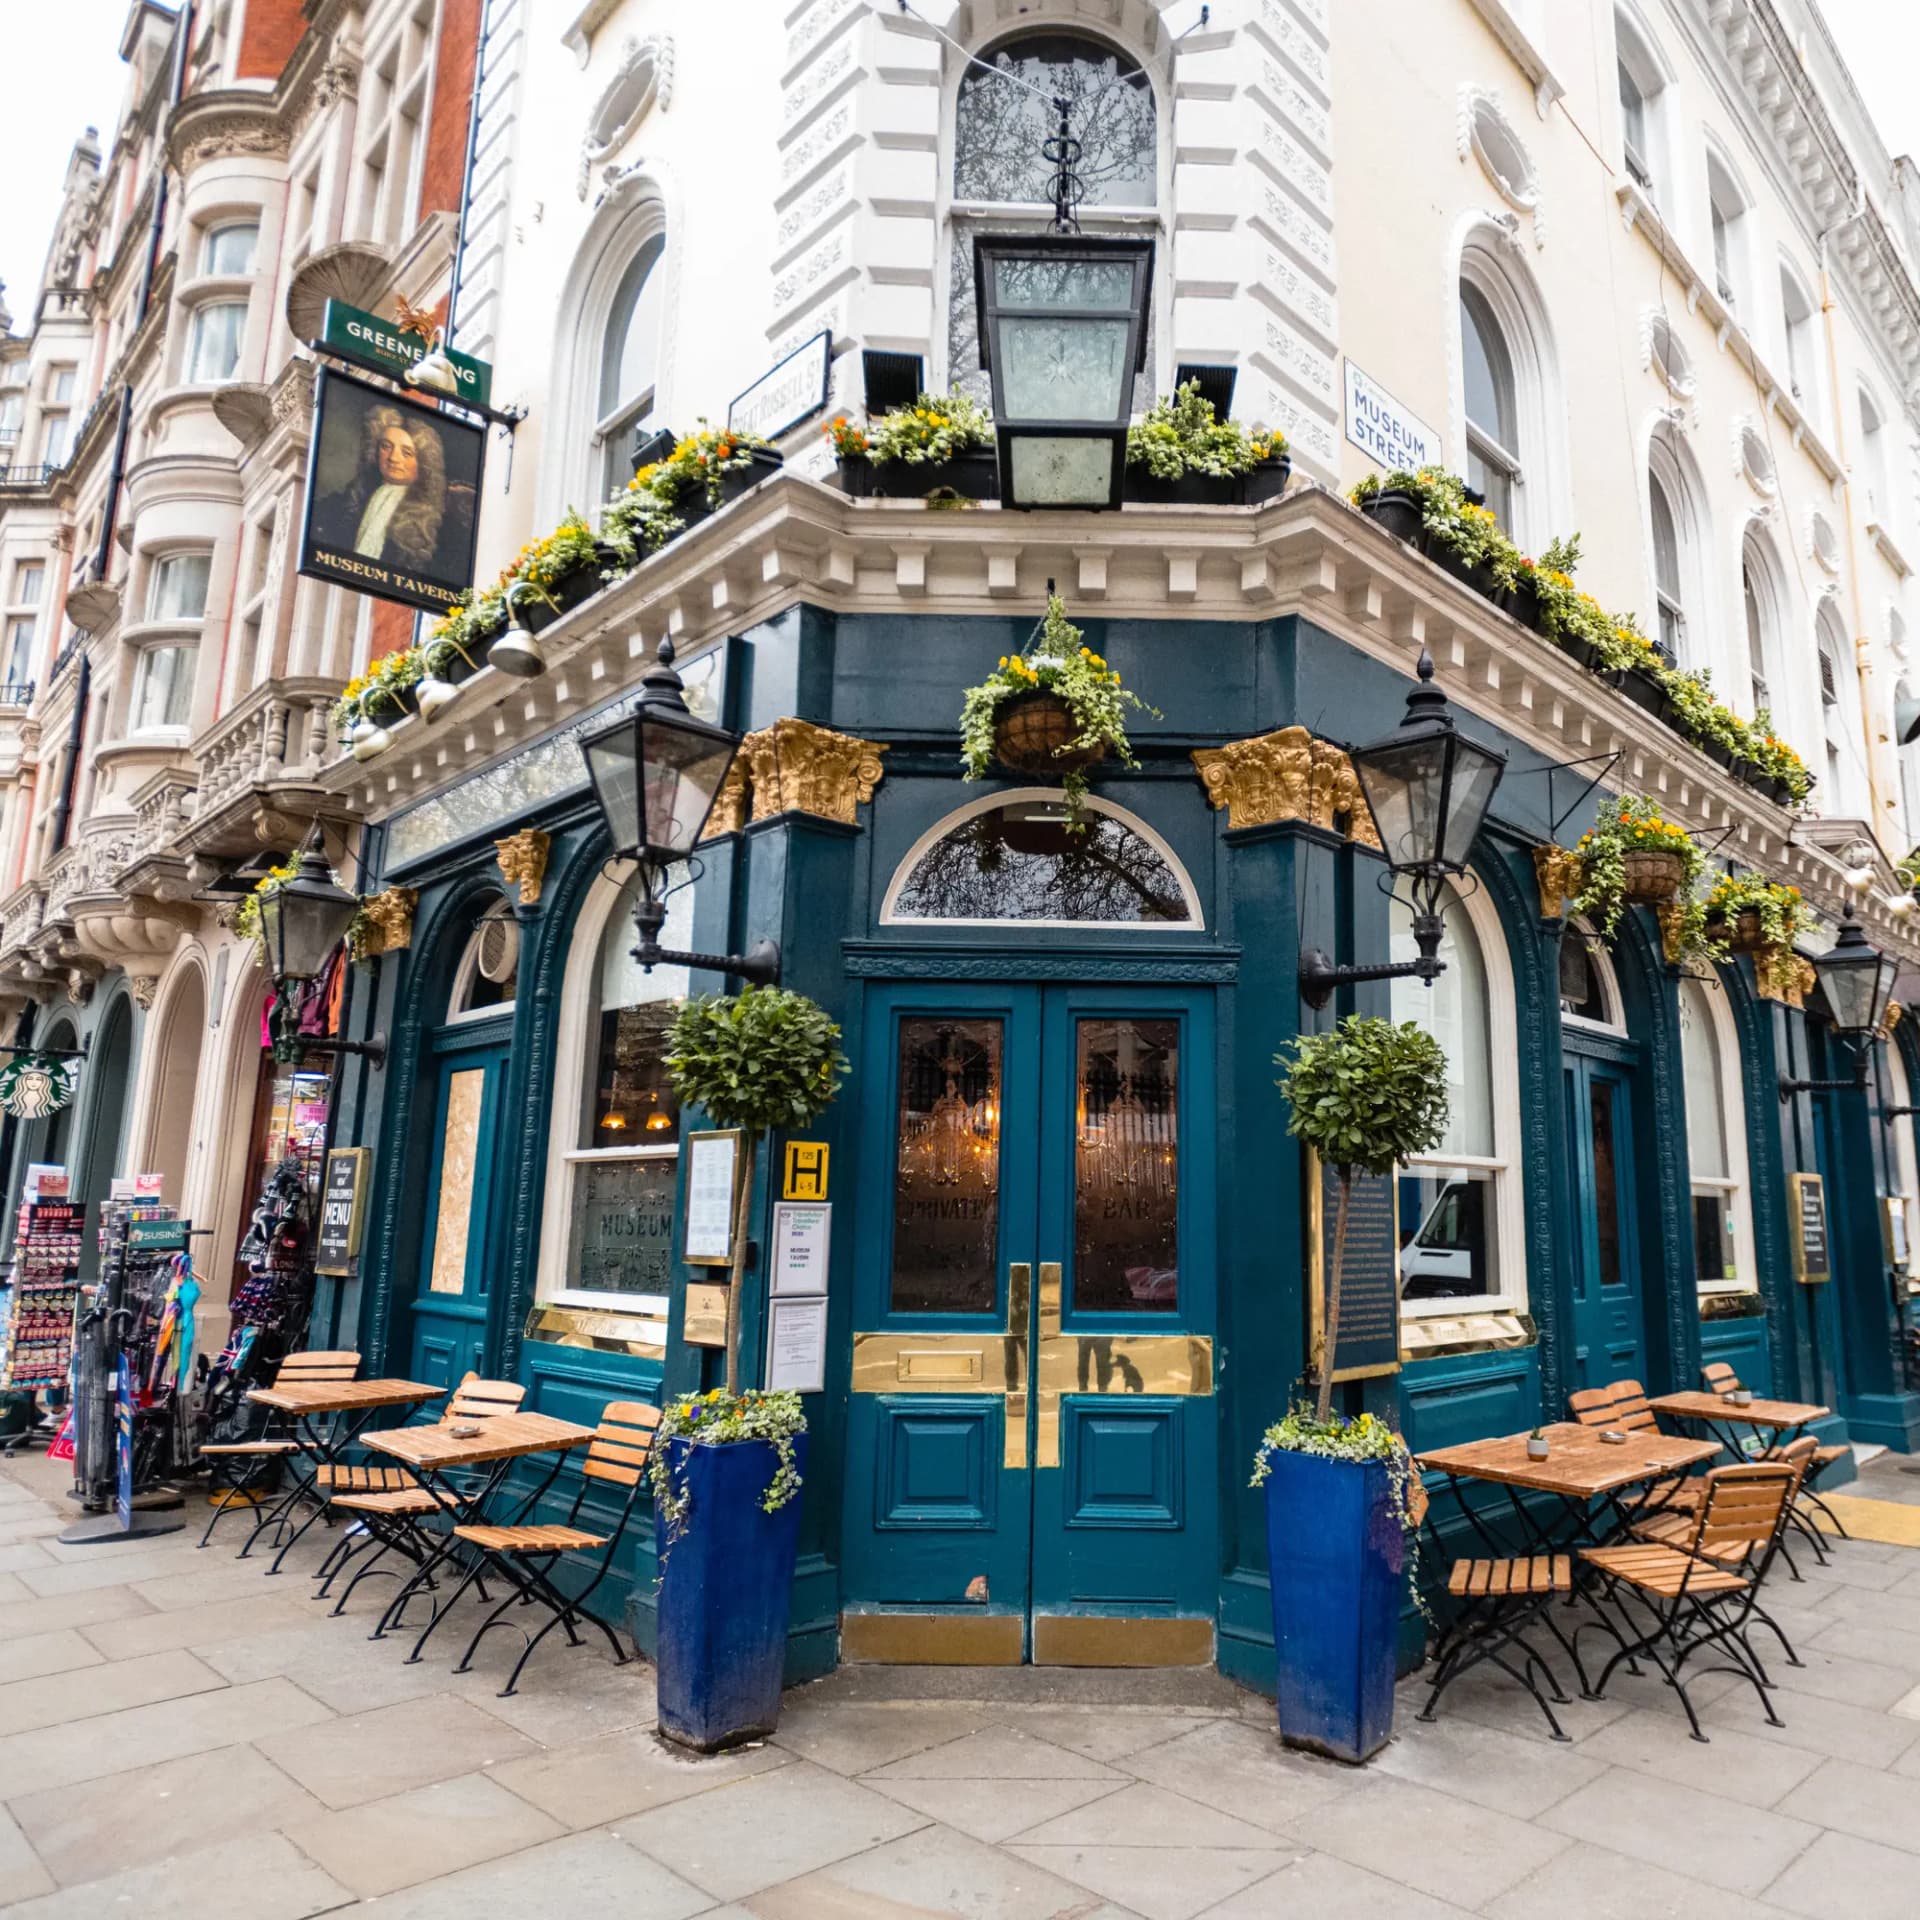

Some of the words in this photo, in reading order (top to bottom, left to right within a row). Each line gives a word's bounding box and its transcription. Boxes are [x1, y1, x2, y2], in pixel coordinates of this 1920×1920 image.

[346, 321, 423, 362] GREENE
[1355, 388, 1425, 462] MUSEUM
[1355, 417, 1415, 470] STREET
[315, 551, 388, 583] MUSEUM
[393, 573, 459, 603] TAVERN
[791, 1148, 822, 1193] H
[324, 1202, 352, 1225] MENU
[602, 1214, 672, 1237] MUSEUM
[1103, 1198, 1150, 1219] BAR
